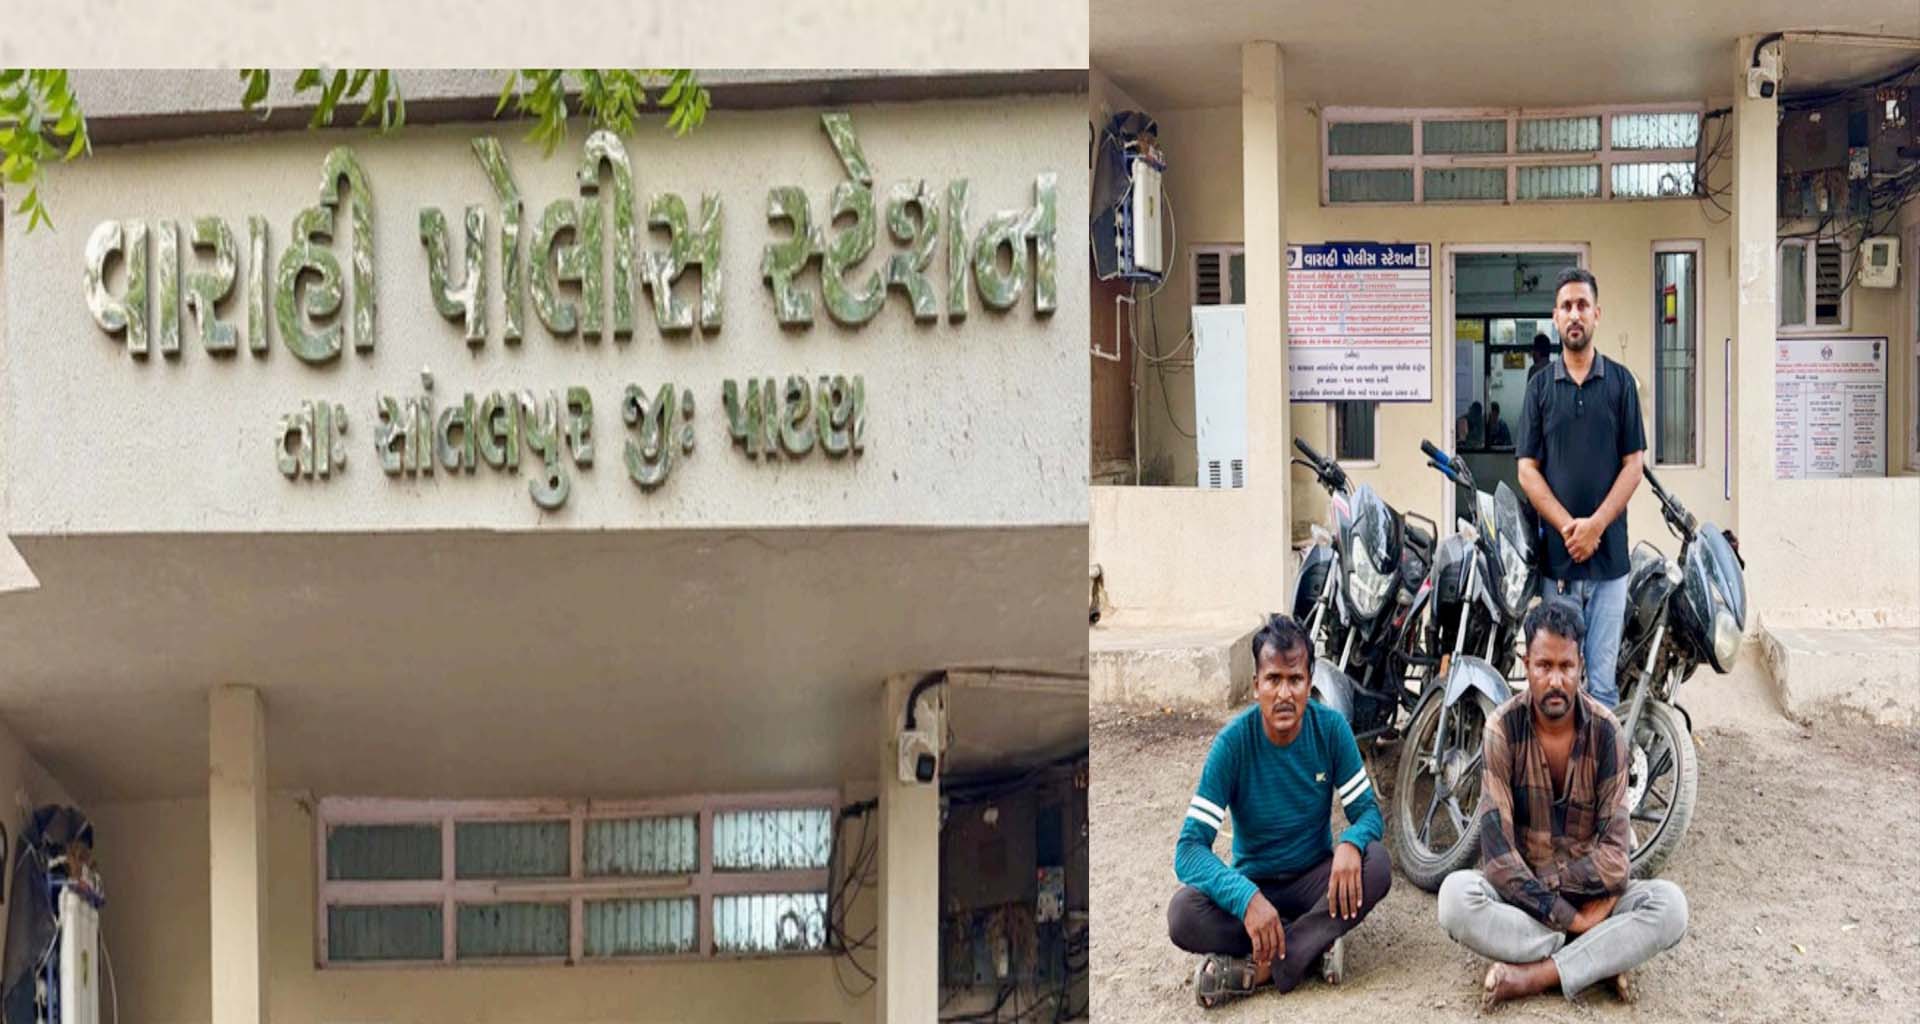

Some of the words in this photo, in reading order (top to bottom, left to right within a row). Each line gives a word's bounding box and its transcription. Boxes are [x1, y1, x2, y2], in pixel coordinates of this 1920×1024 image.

[83, 146, 376, 365] વારાહી
[418, 129, 722, 347] પોલીસ
[761, 112, 1059, 329] સ્ટેશન
[1303, 248, 1338, 267] વારાહી
[1342, 247, 1376, 266] પોલીસ
[1380, 247, 1414, 266] સ્ટેશન
[374, 364, 595, 510] સાંતલપુર
[721, 375, 866, 461] પાટણ
